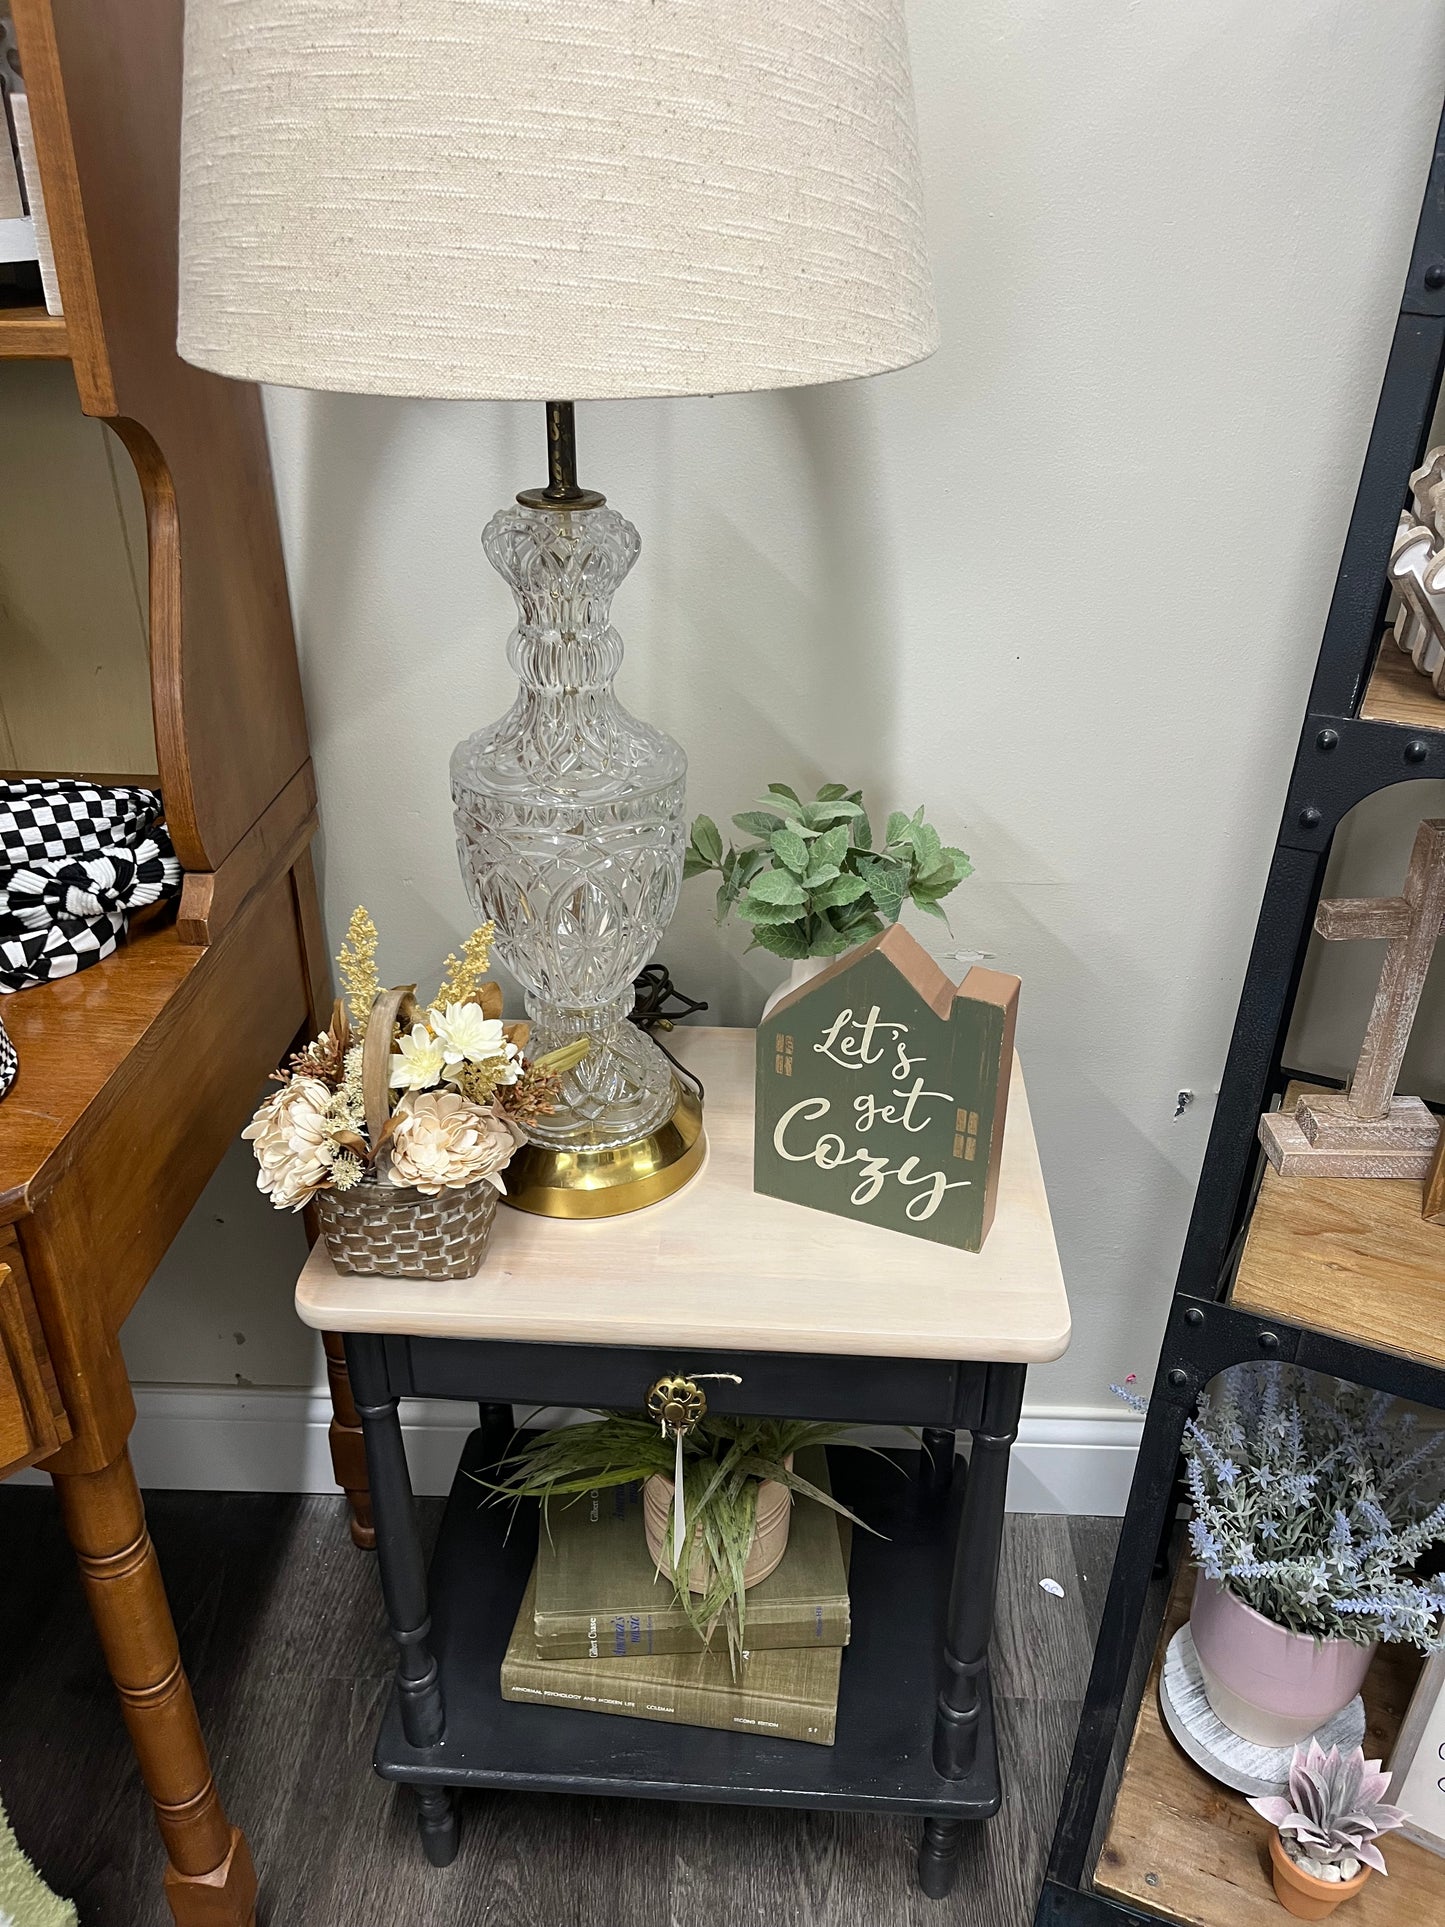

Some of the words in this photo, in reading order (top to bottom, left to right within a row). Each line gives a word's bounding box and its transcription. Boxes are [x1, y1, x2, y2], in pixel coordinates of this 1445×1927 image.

[813, 1005, 927, 1080] Let's
[853, 1077, 954, 1132] get
[773, 1097, 972, 1221] Cozy
